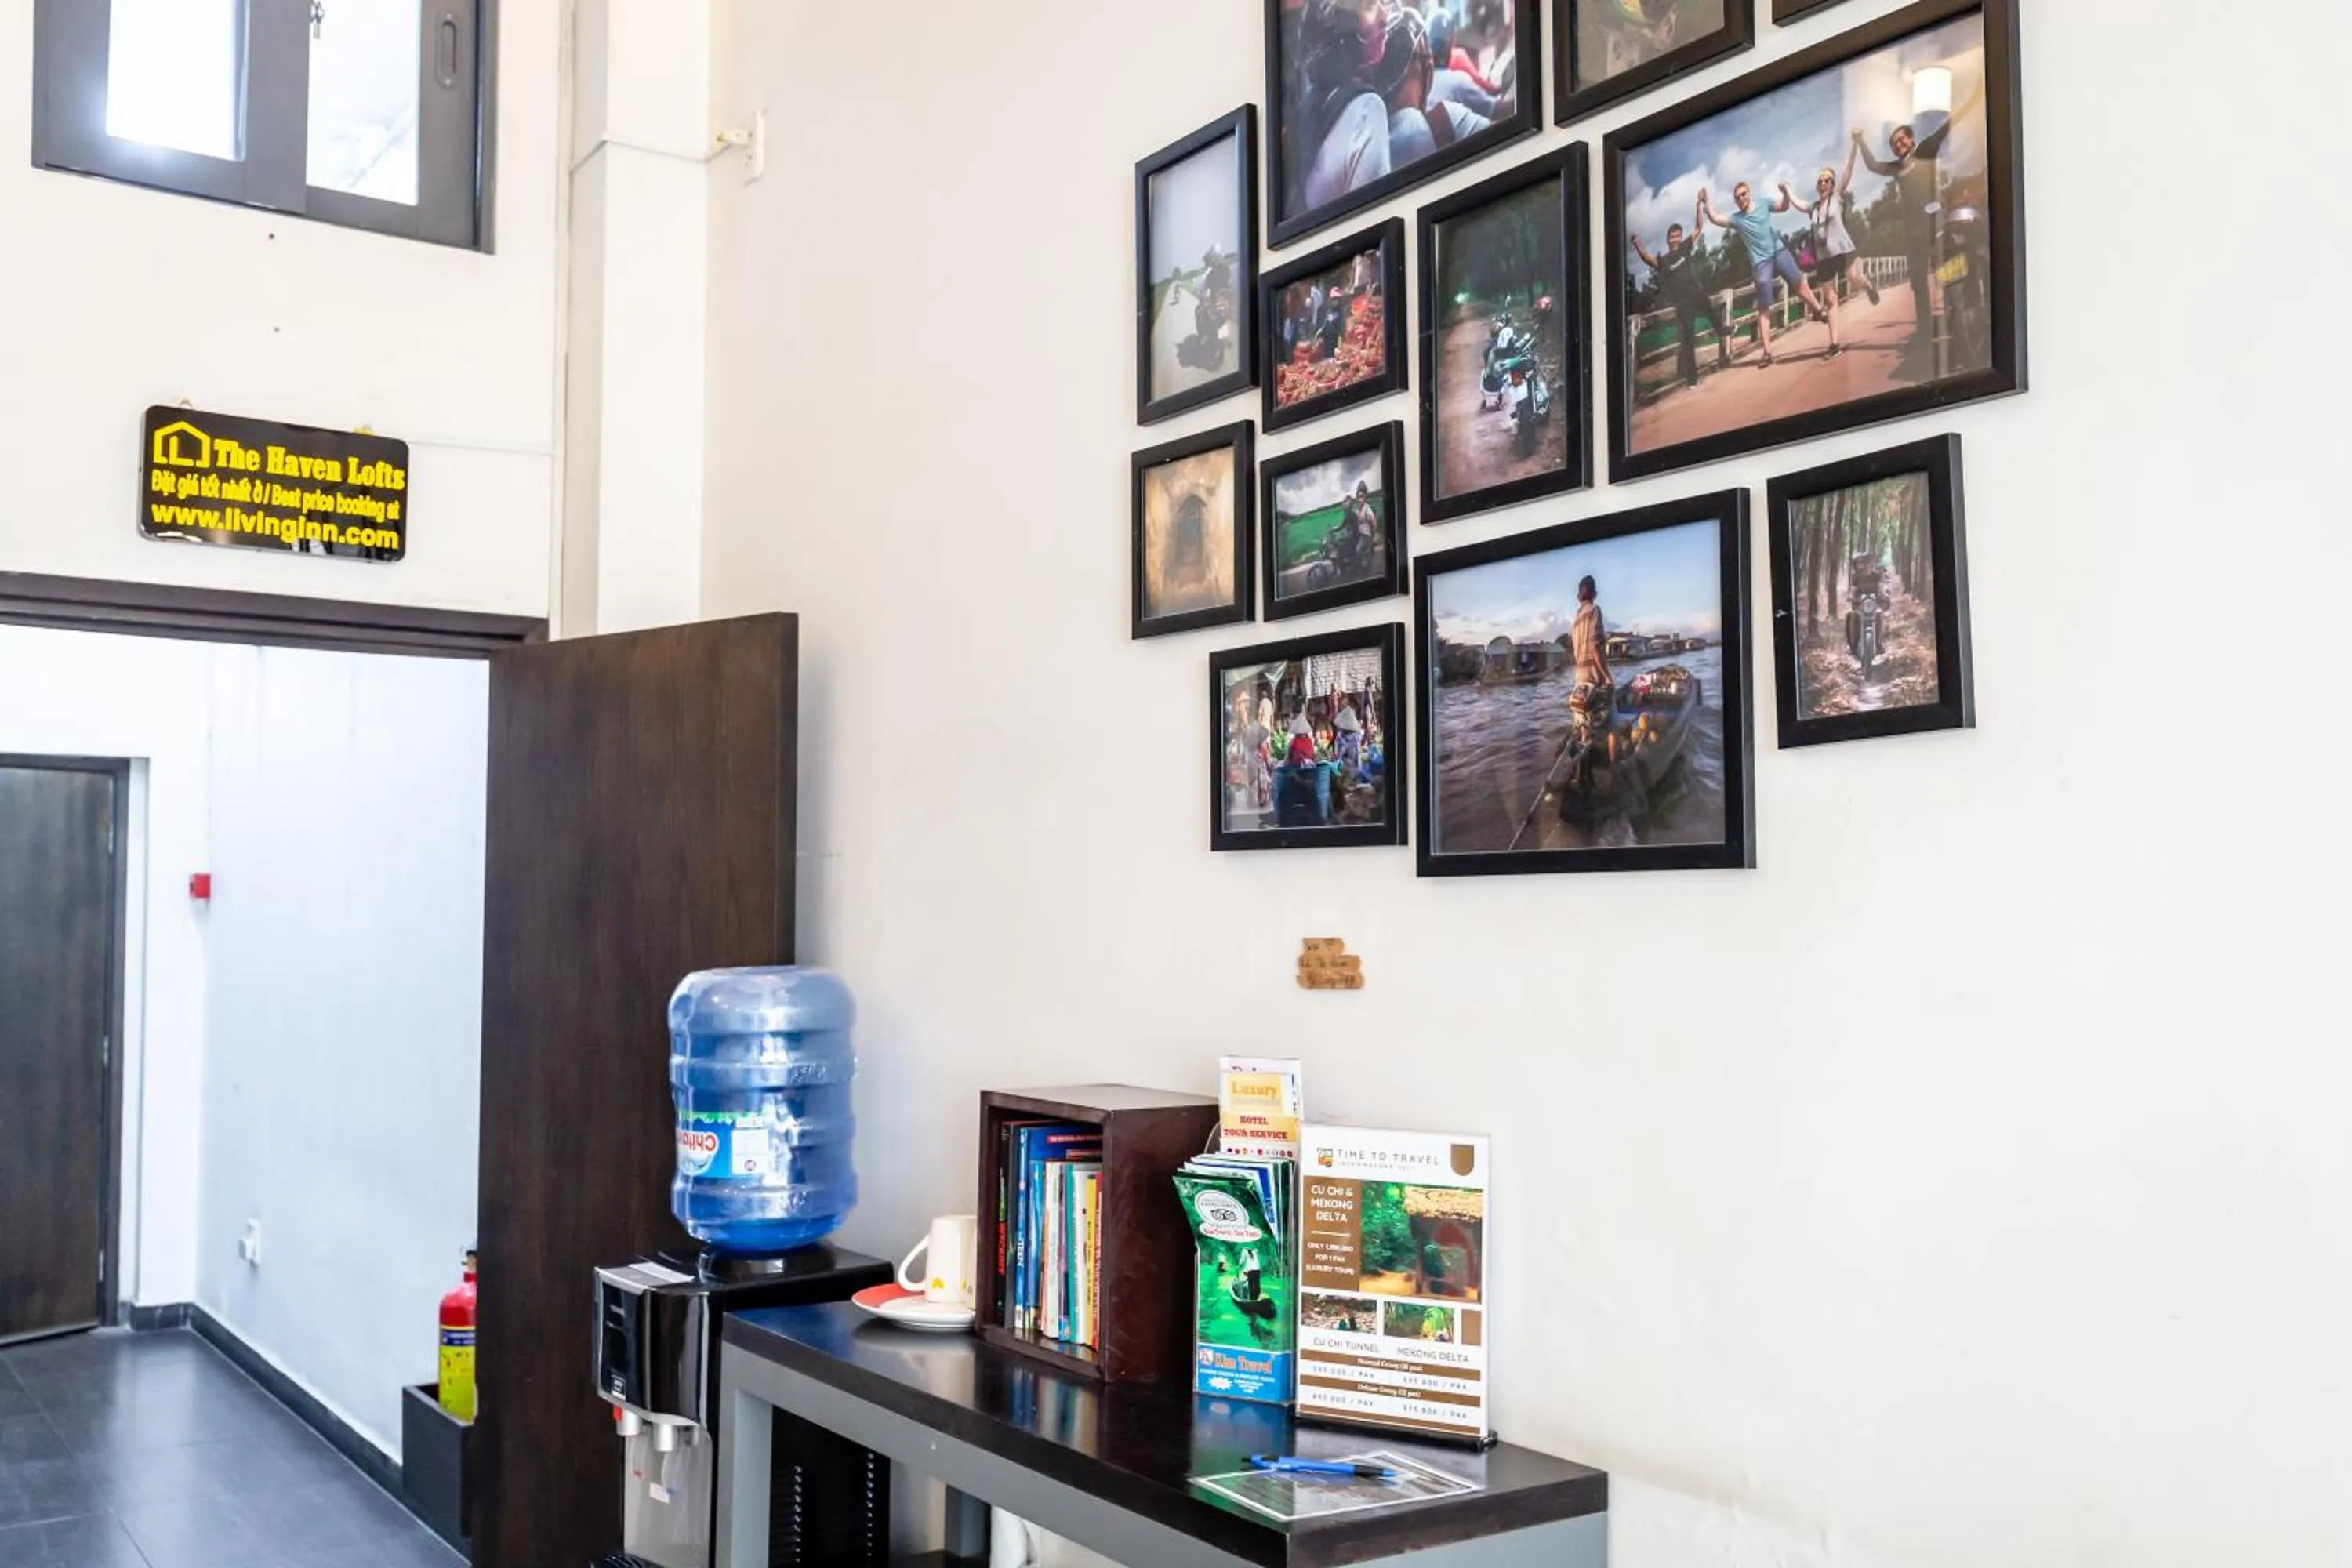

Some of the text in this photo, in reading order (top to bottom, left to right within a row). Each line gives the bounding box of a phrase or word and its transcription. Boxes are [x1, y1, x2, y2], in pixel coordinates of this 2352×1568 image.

[213, 437, 406, 491] The Haven Lofts
[271, 484, 301, 509] Best
[302, 488, 335, 514] price
[336, 492, 385, 523] booking
[387, 499, 400, 521] at
[151, 504, 399, 550] www.livinginn.com
[1232, 1082, 1277, 1100] Luxury
[1240, 1116, 1269, 1125] HOTEL
[1250, 1130, 1288, 1140] SERVICE
[1338, 1149, 1439, 1166] TIME TO TRAVEL
[1310, 1185, 1325, 1195] CU
[1327, 1185, 1344, 1196] CHI
[1310, 1197, 1354, 1210] MEKONG
[1316, 1211, 1348, 1223] DELTA
[1313, 1337, 1380, 1353] CU CHI TUNNEL
[1397, 1346, 1468, 1363] MEKONG DELTA
